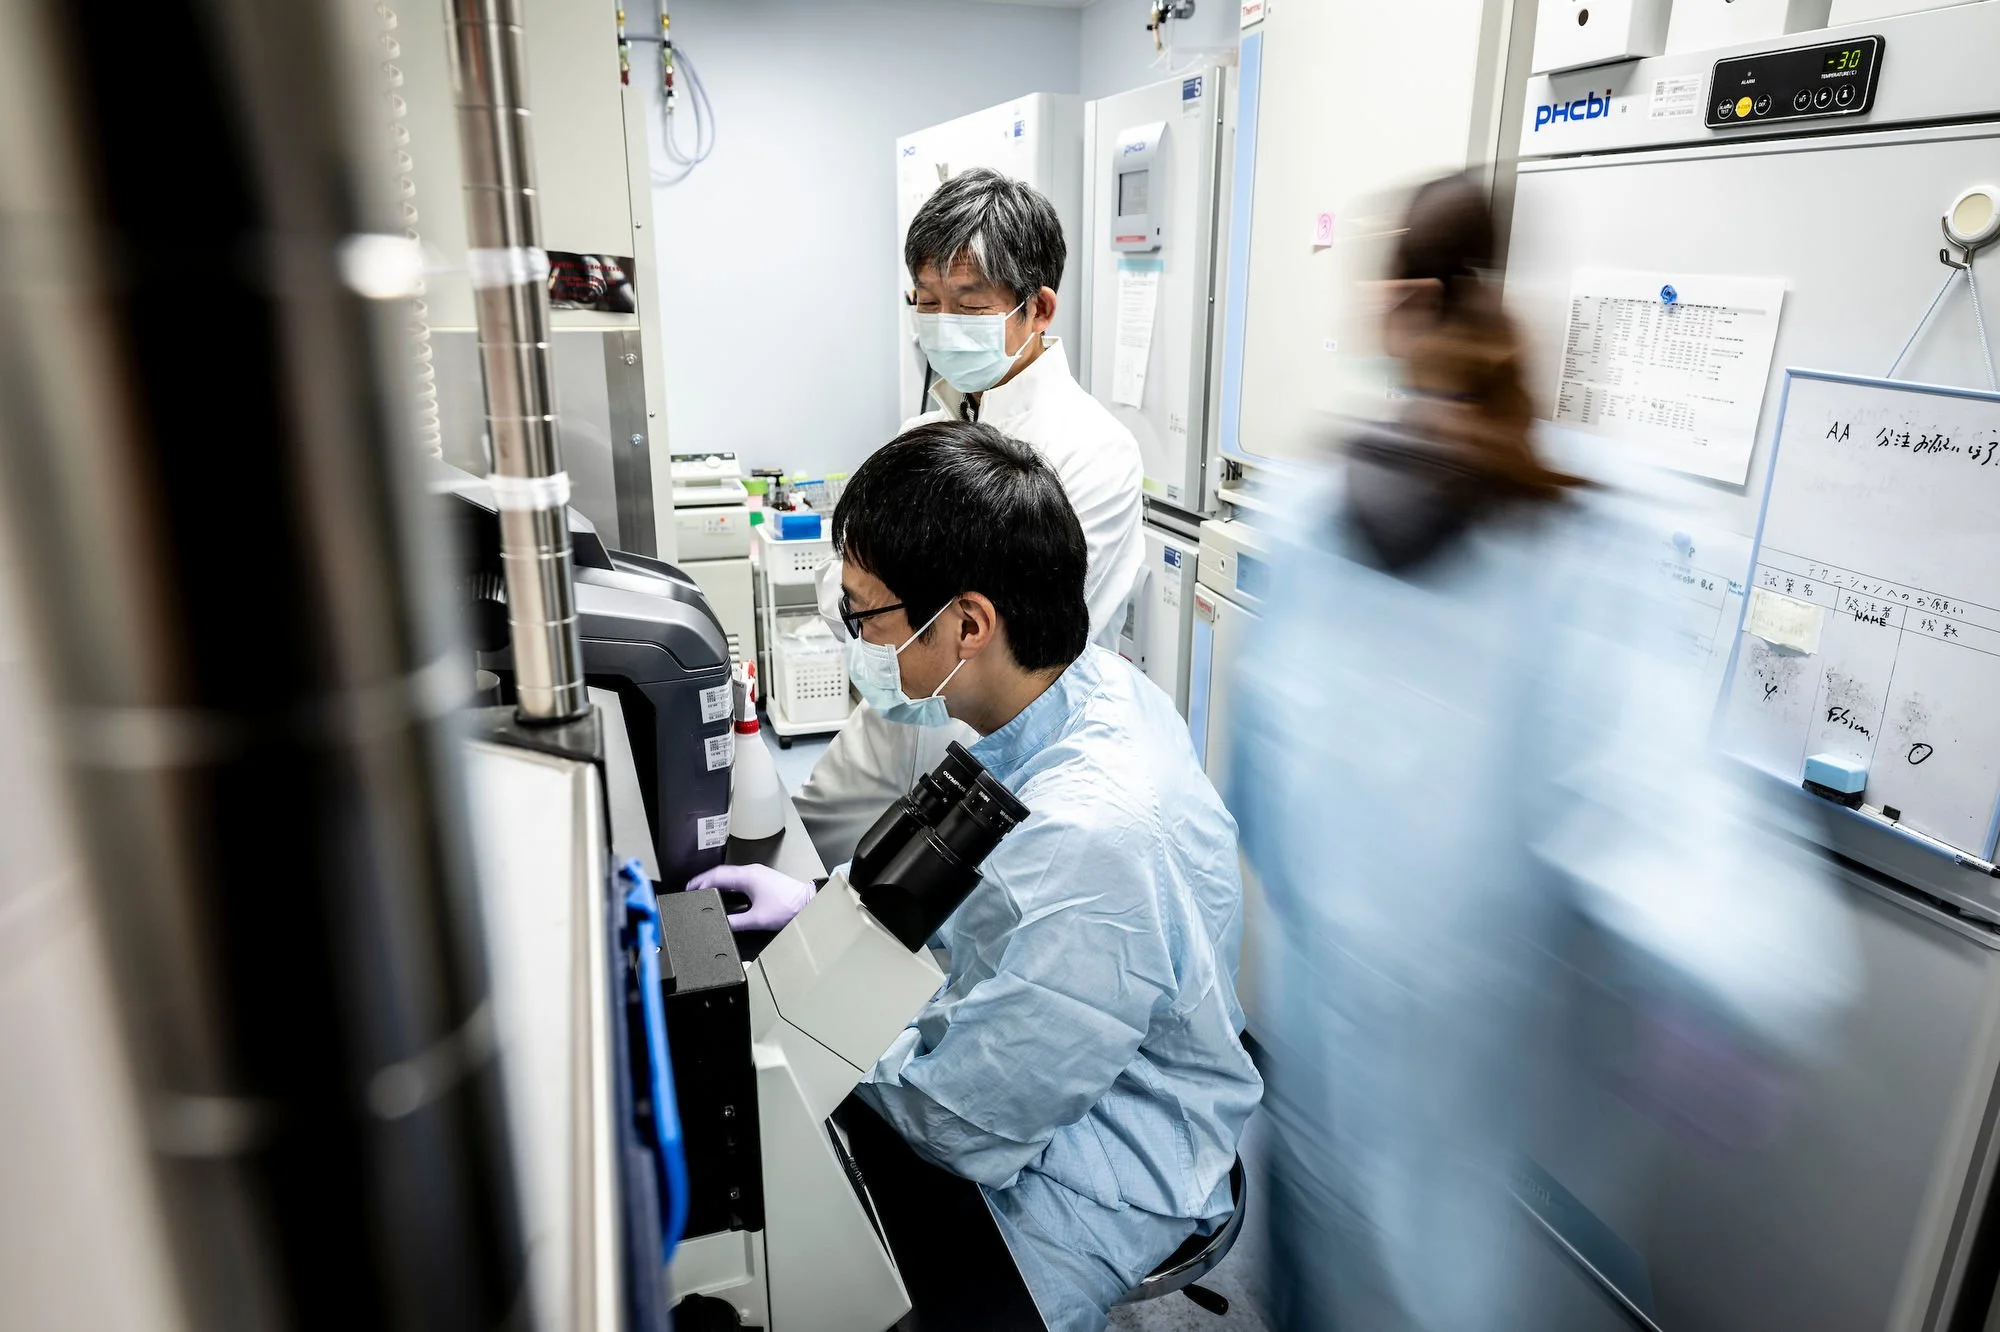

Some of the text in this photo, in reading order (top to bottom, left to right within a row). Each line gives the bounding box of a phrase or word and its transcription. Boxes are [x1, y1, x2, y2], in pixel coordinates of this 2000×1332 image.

[1827, 49, 1861, 70] -30
[1826, 421, 1850, 443] AA
[1174, 551, 1181, 567] 5
[1763, 571, 1813, 597] 試薬名
[1845, 596, 1892, 618] 発注者
[1854, 610, 1887, 627] NAME
[1920, 618, 1959, 638] 残数
[943, 770, 966, 792] OLYMPUS
